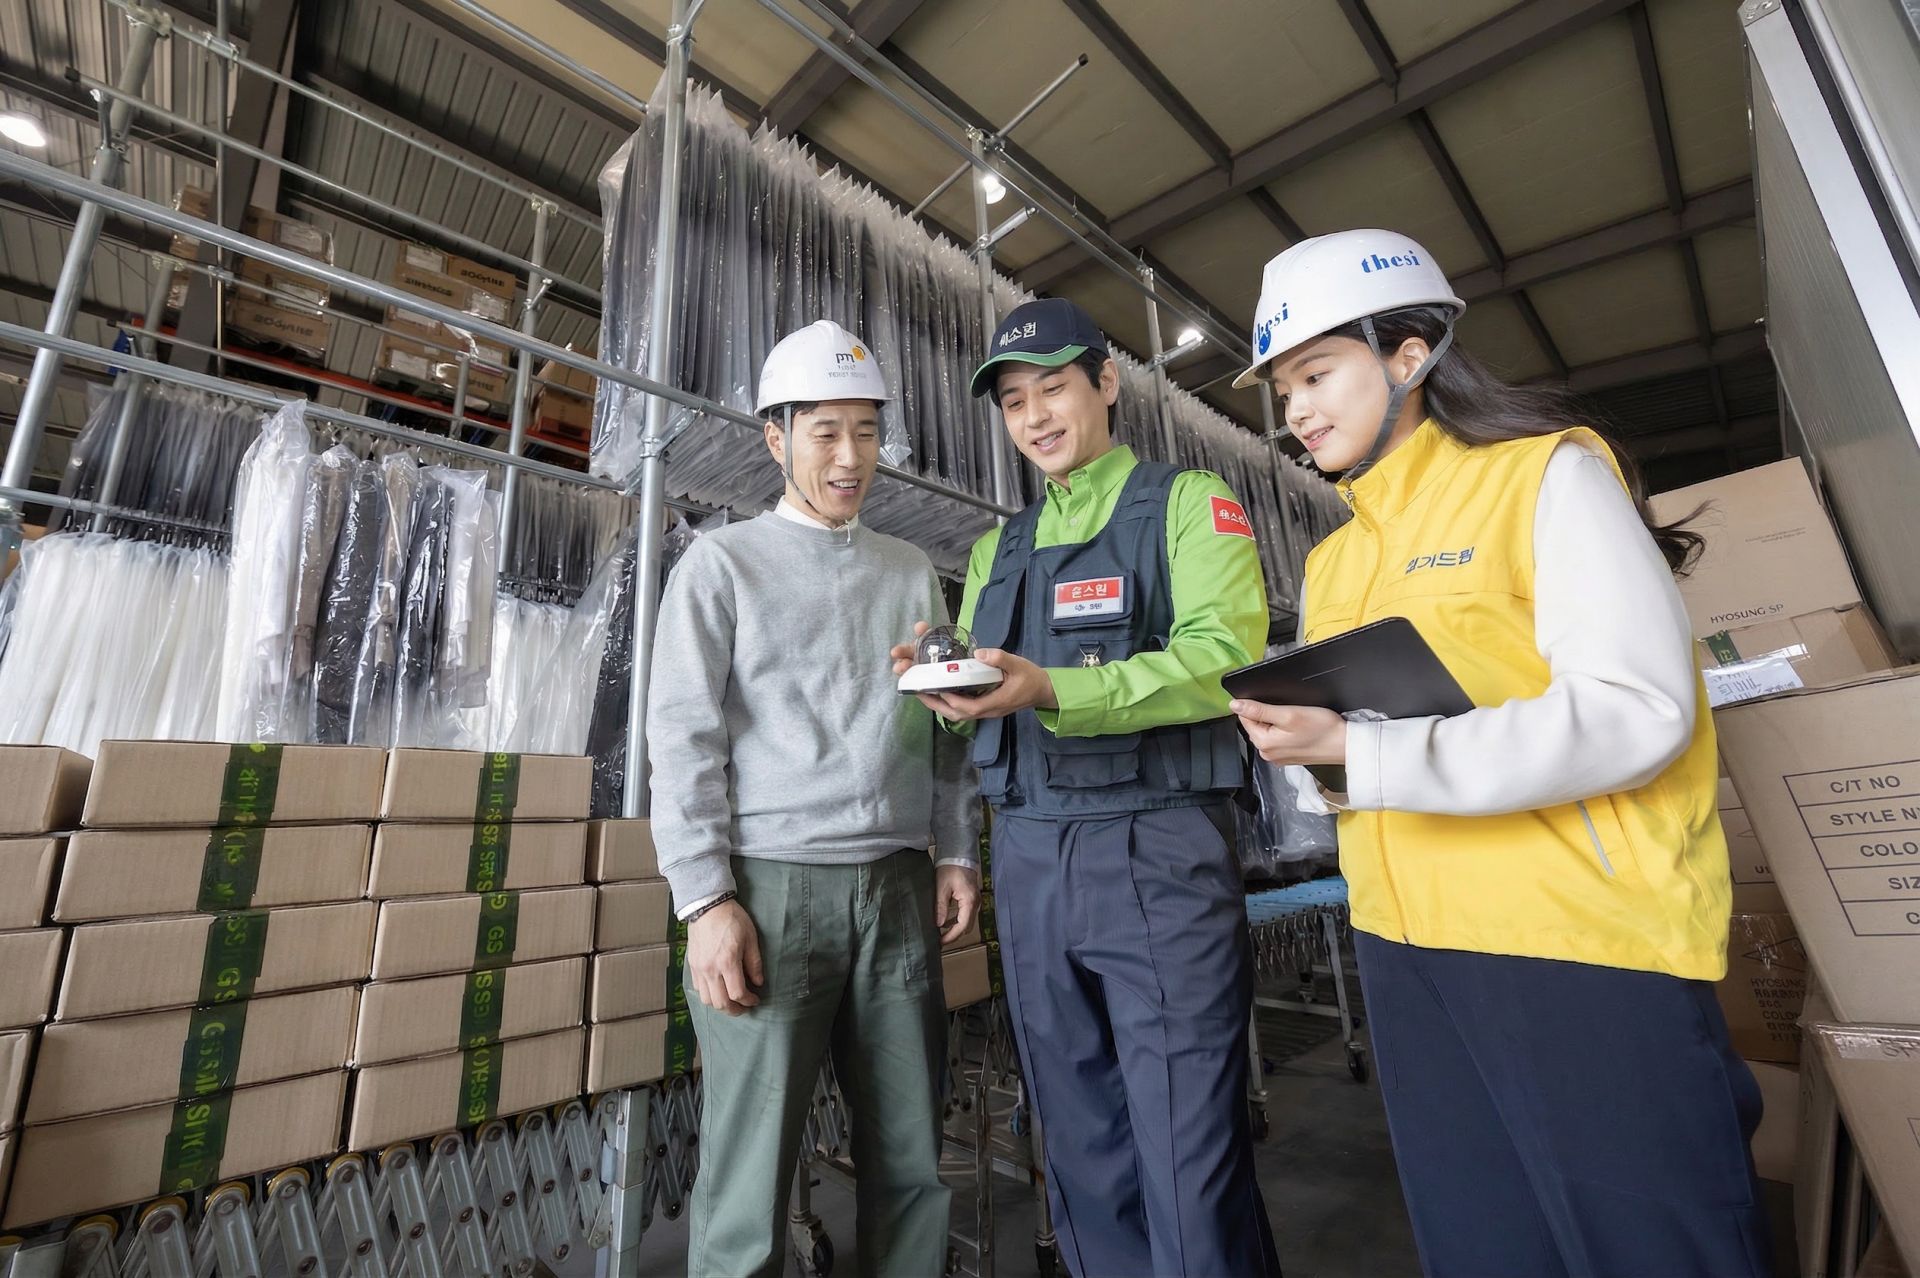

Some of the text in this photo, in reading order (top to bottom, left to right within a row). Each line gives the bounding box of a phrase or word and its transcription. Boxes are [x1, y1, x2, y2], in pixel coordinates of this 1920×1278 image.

[1361, 250, 1421, 273] thesi
[1710, 603, 1784, 624] HYOSUNG SP
[1829, 775, 1900, 794] C/T NO
[1829, 809, 1897, 826] STYLE
